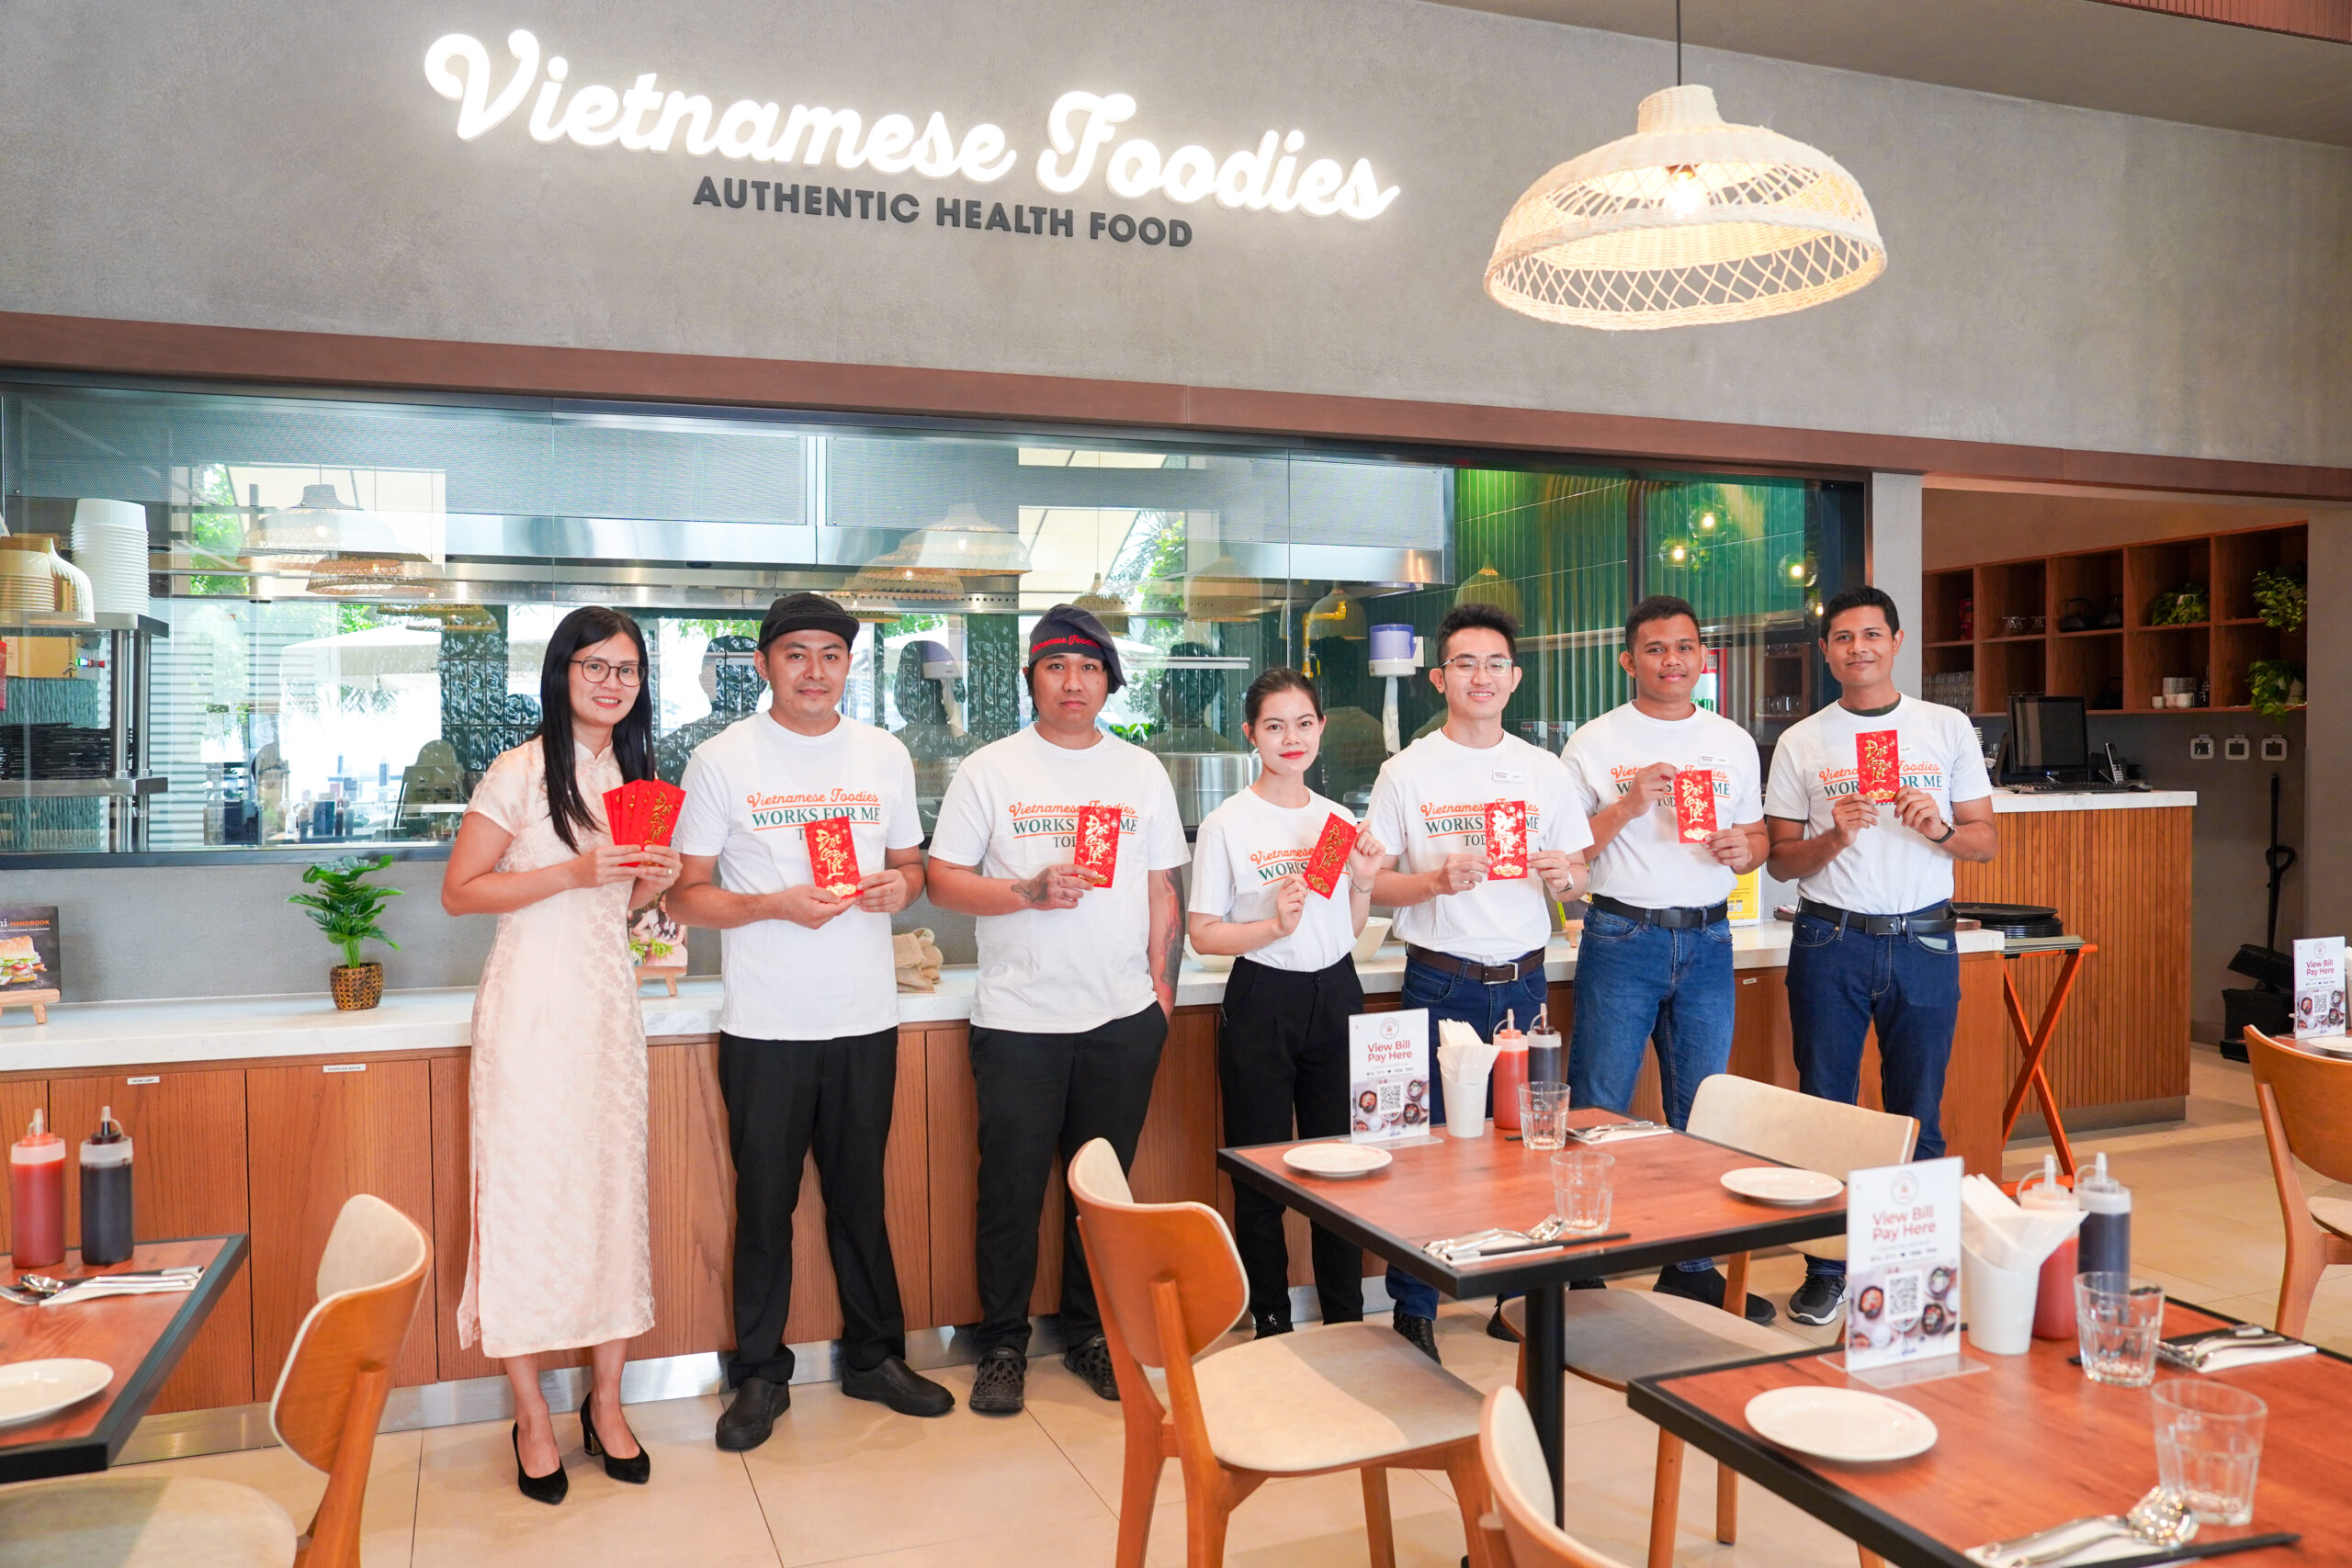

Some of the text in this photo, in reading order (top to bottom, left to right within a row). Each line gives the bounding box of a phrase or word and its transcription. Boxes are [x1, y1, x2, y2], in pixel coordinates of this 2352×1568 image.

[424, 29, 1400, 221] Vietnamese Foodies
[692, 176, 1193, 248] AUTHENTIC HEALTH FOOD
[1819, 768, 1859, 782] Vietna
[1712, 782, 1730, 795] ME
[1824, 780, 1860, 796] WOR
[1924, 775, 1942, 787] ME
[747, 788, 879, 808] Vietnamese Foodies
[752, 807, 881, 826] WORKS FOR ME
[1420, 802, 1485, 817] Vietnames
[1012, 818, 1138, 834] WORKS ME
[1426, 817, 1483, 834] WORKS
[1250, 847, 1315, 864] Vietnamese
[2306, 960, 2322, 968] View
[2306, 968, 2318, 976] Pay
[1367, 1040, 1410, 1053] View Bill
[1367, 1051, 1412, 1063] Pay Here
[1872, 1204, 1934, 1225] View Bill
[1872, 1223, 1936, 1243] Pay Here
